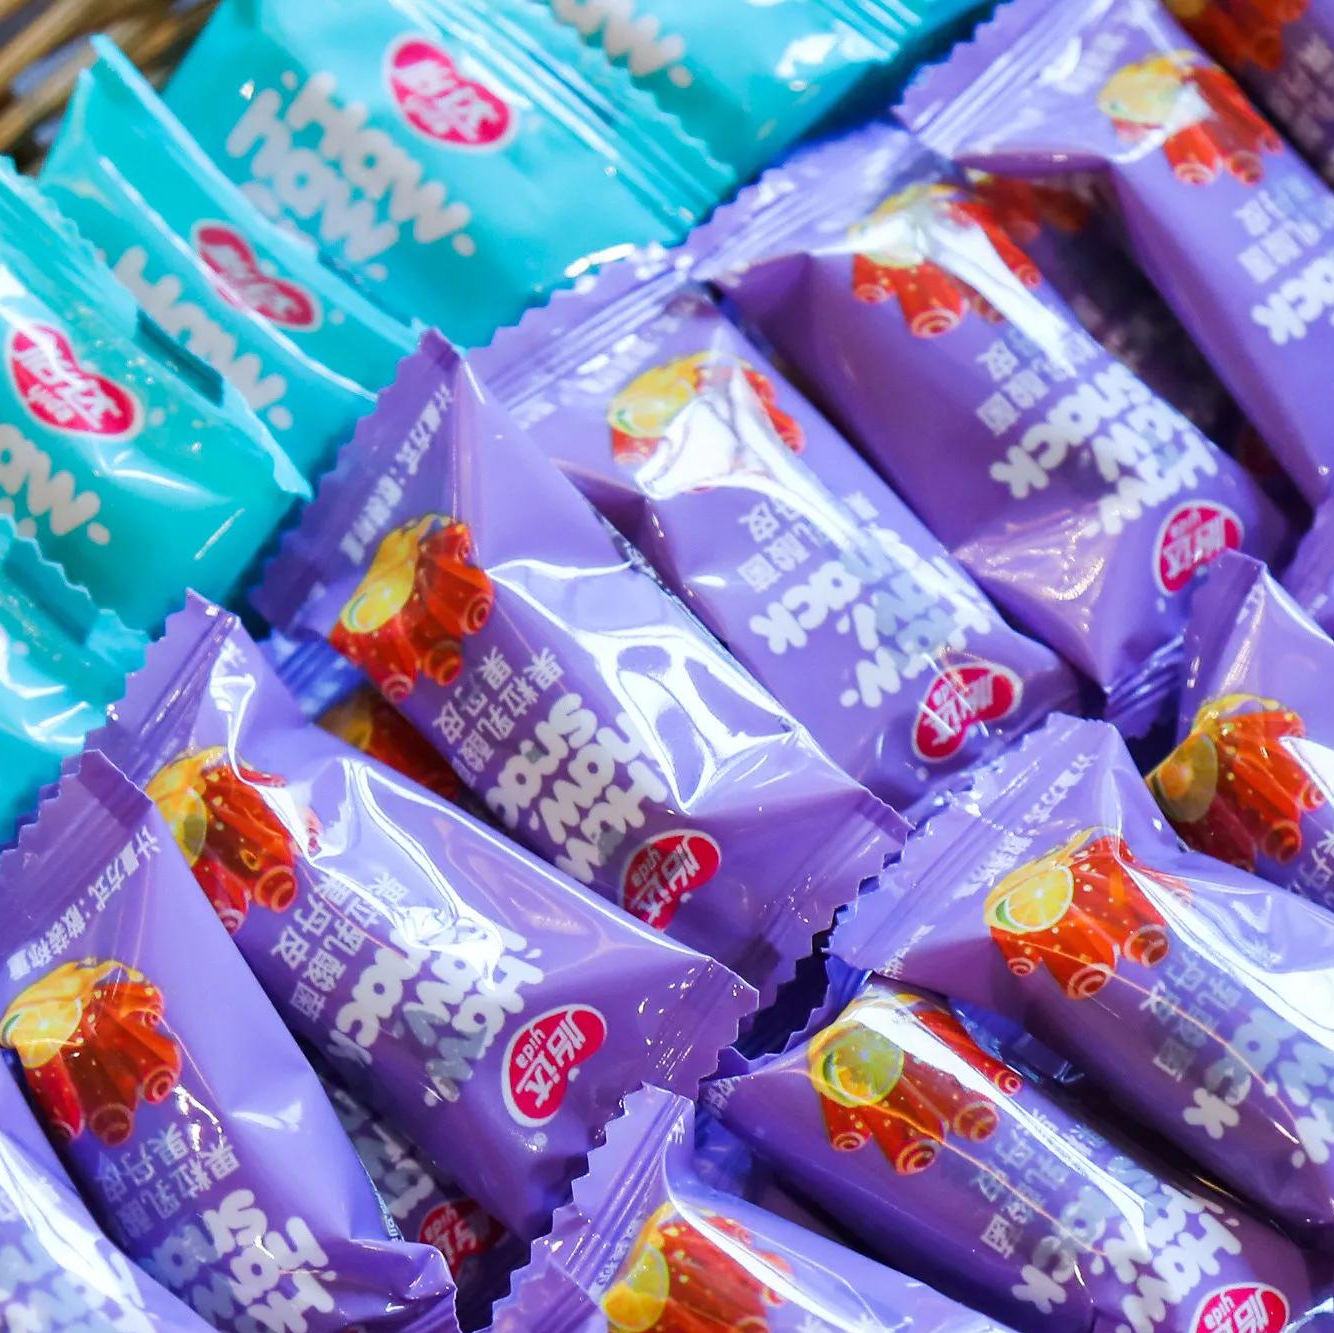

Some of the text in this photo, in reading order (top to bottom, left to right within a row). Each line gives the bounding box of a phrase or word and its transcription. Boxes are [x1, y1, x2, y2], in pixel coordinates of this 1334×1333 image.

[5, 824, 159, 981] 计量方式：散装称重
[510, 1026, 548, 1070] yida
[515, 1015, 587, 1108] 怡达
